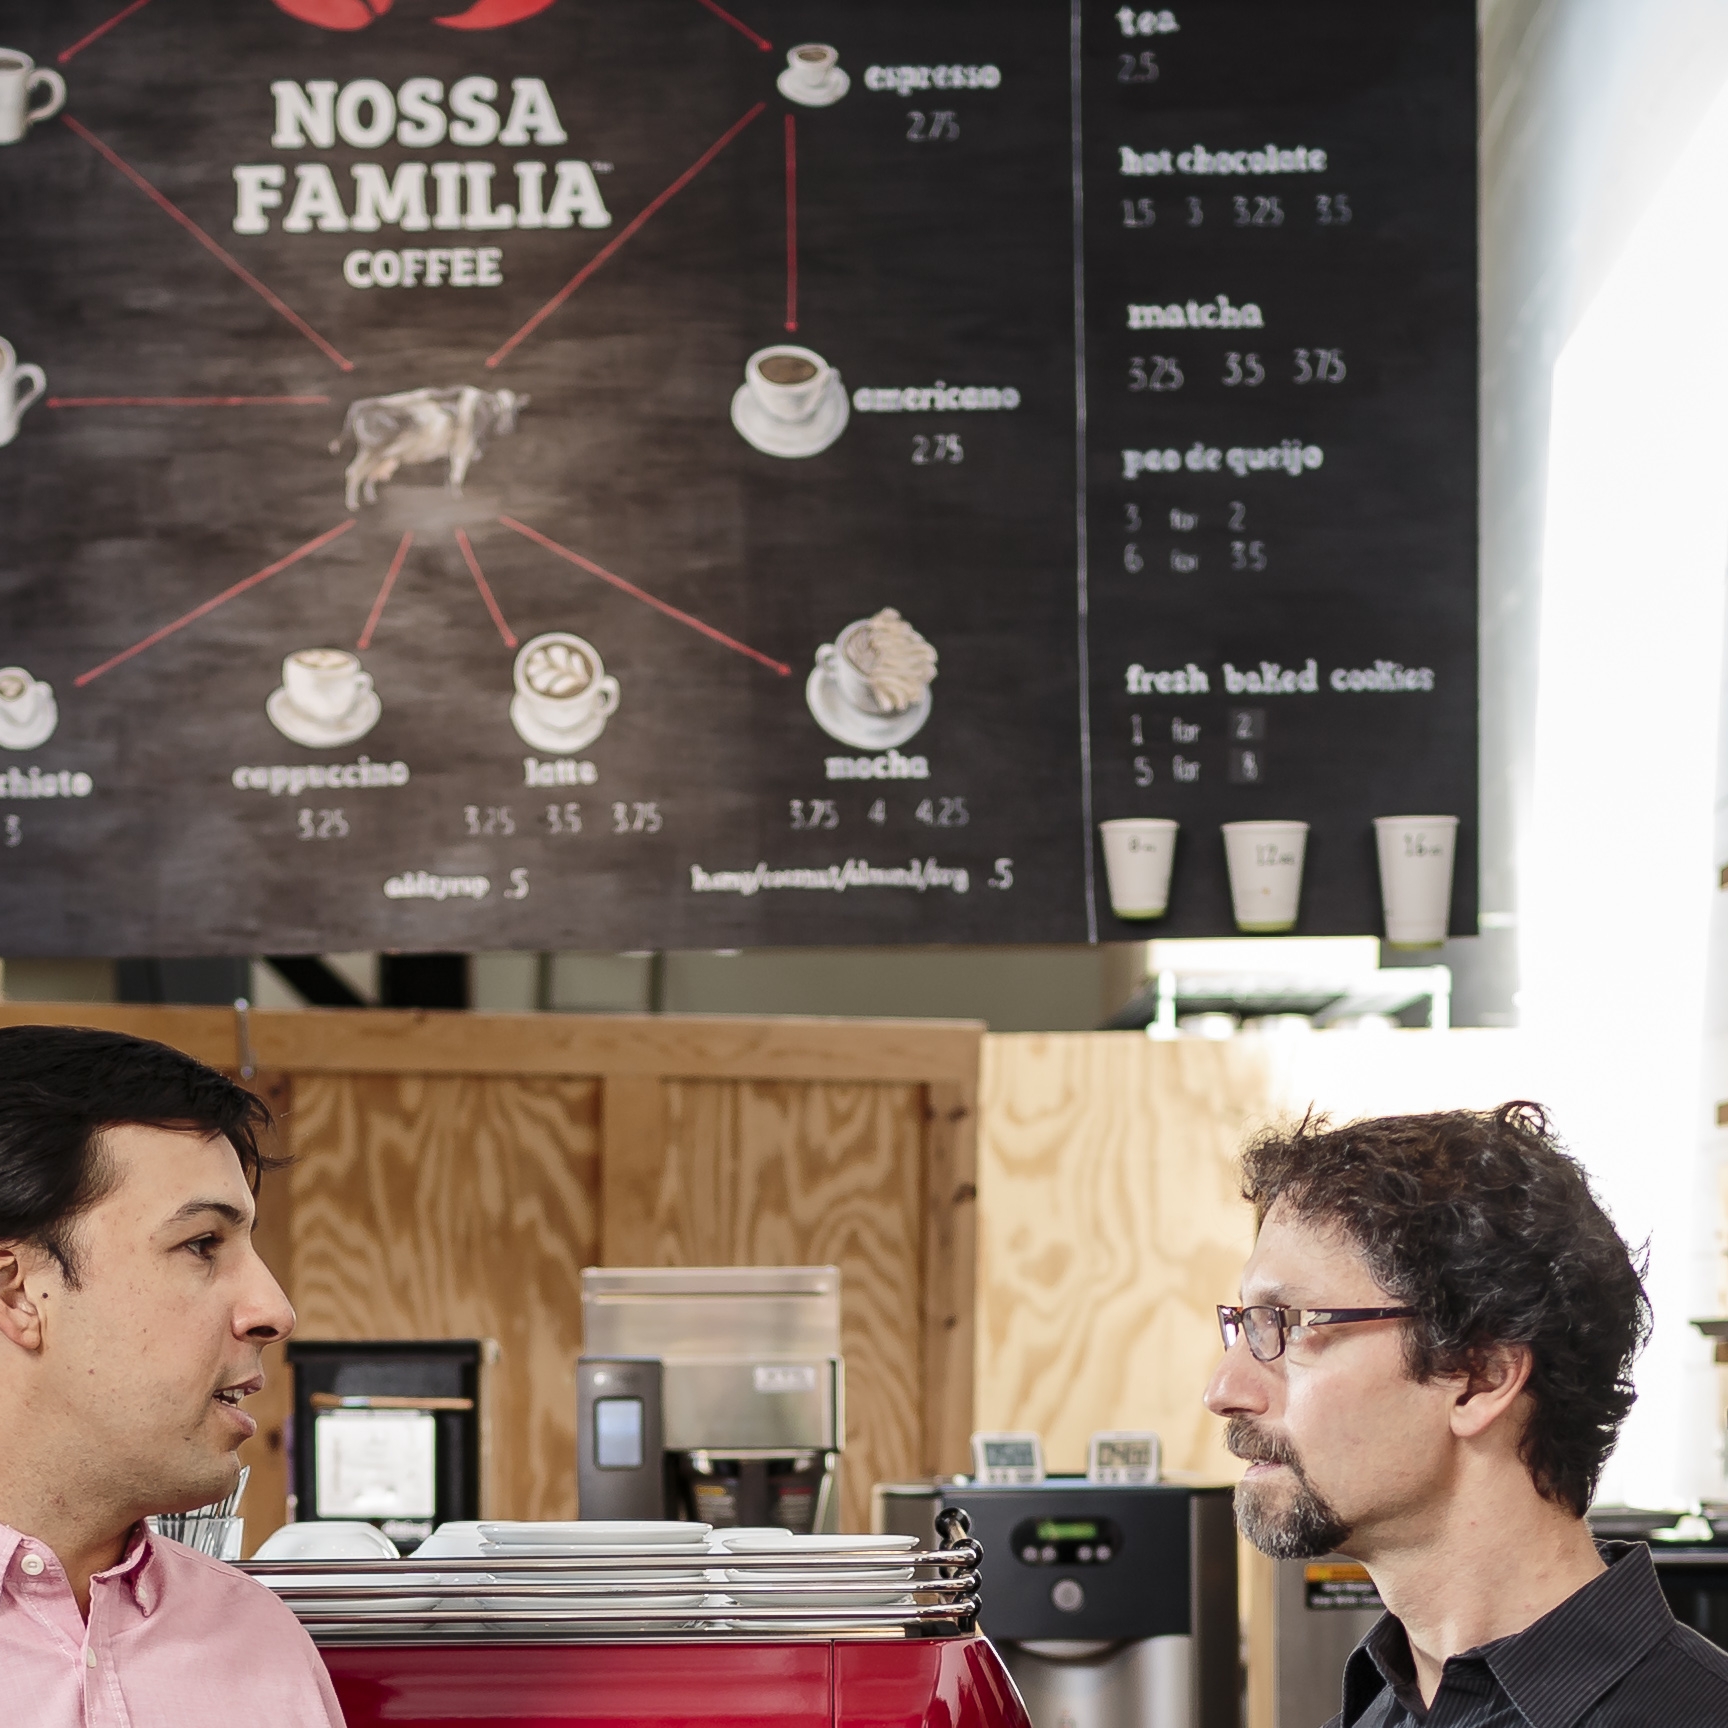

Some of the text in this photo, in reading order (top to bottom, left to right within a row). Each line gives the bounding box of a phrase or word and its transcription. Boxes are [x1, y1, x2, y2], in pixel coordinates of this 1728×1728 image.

[1115, 6, 1180, 37] tea
[865, 65, 1001, 96] espresso
[271, 76, 568, 148] NOSSA
[1119, 143, 1328, 176] hot chocolate
[233, 160, 612, 234] FAMILIA
[343, 247, 503, 287] COFFEE
[1127, 294, 1264, 330] matcha
[854, 382, 1020, 412] americano
[1186, 439, 1323, 477] de queijo
[1126, 658, 1435, 693] fresh baked cookies
[232, 755, 410, 796] cappuccino
[522, 756, 599, 788] latte
[825, 749, 930, 780] mocha
